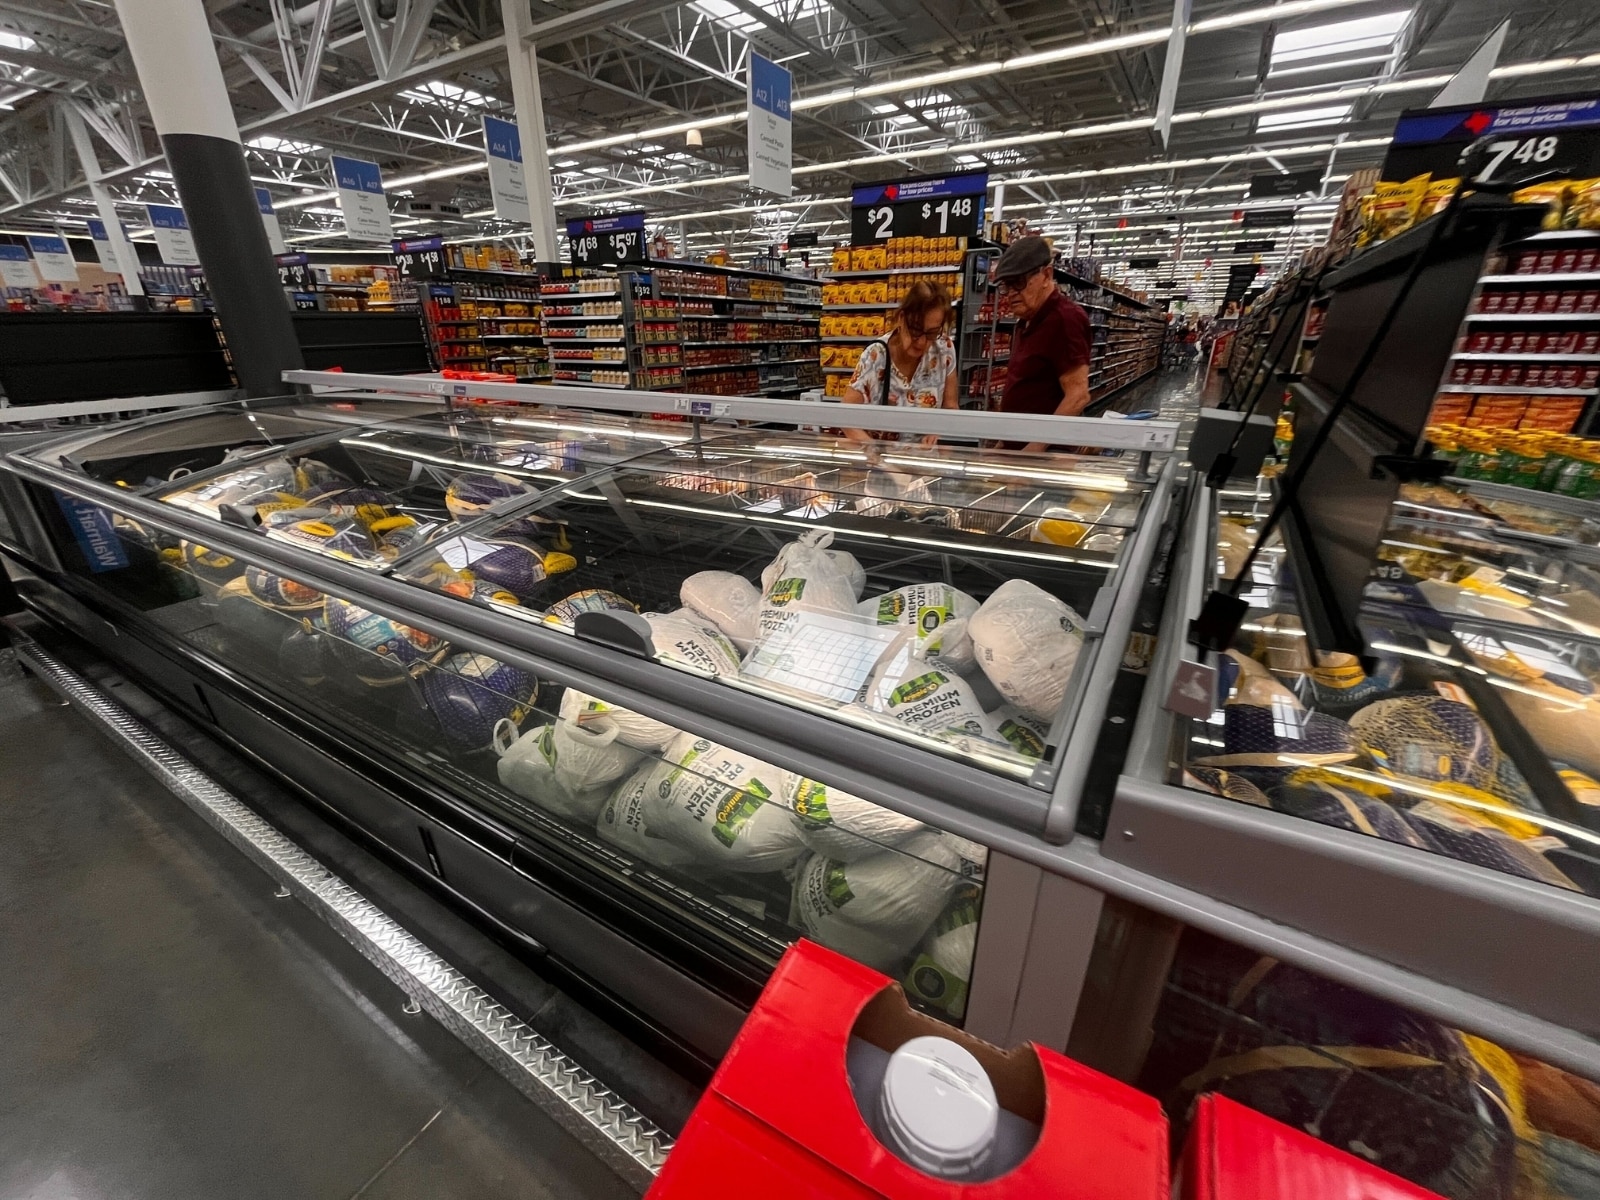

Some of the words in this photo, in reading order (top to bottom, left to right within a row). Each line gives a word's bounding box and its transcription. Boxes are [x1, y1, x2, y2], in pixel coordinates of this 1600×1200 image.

[756, 87, 767, 102] A12
[776, 98, 788, 112] A13
[492, 142, 506, 153] A14
[867, 206, 894, 239] $2
[896, 689, 961, 721] PREMIUM
[905, 699, 962, 726] FROZEN
[684, 760, 732, 813] FROZEN
[693, 763, 745, 823] PREMIUM
